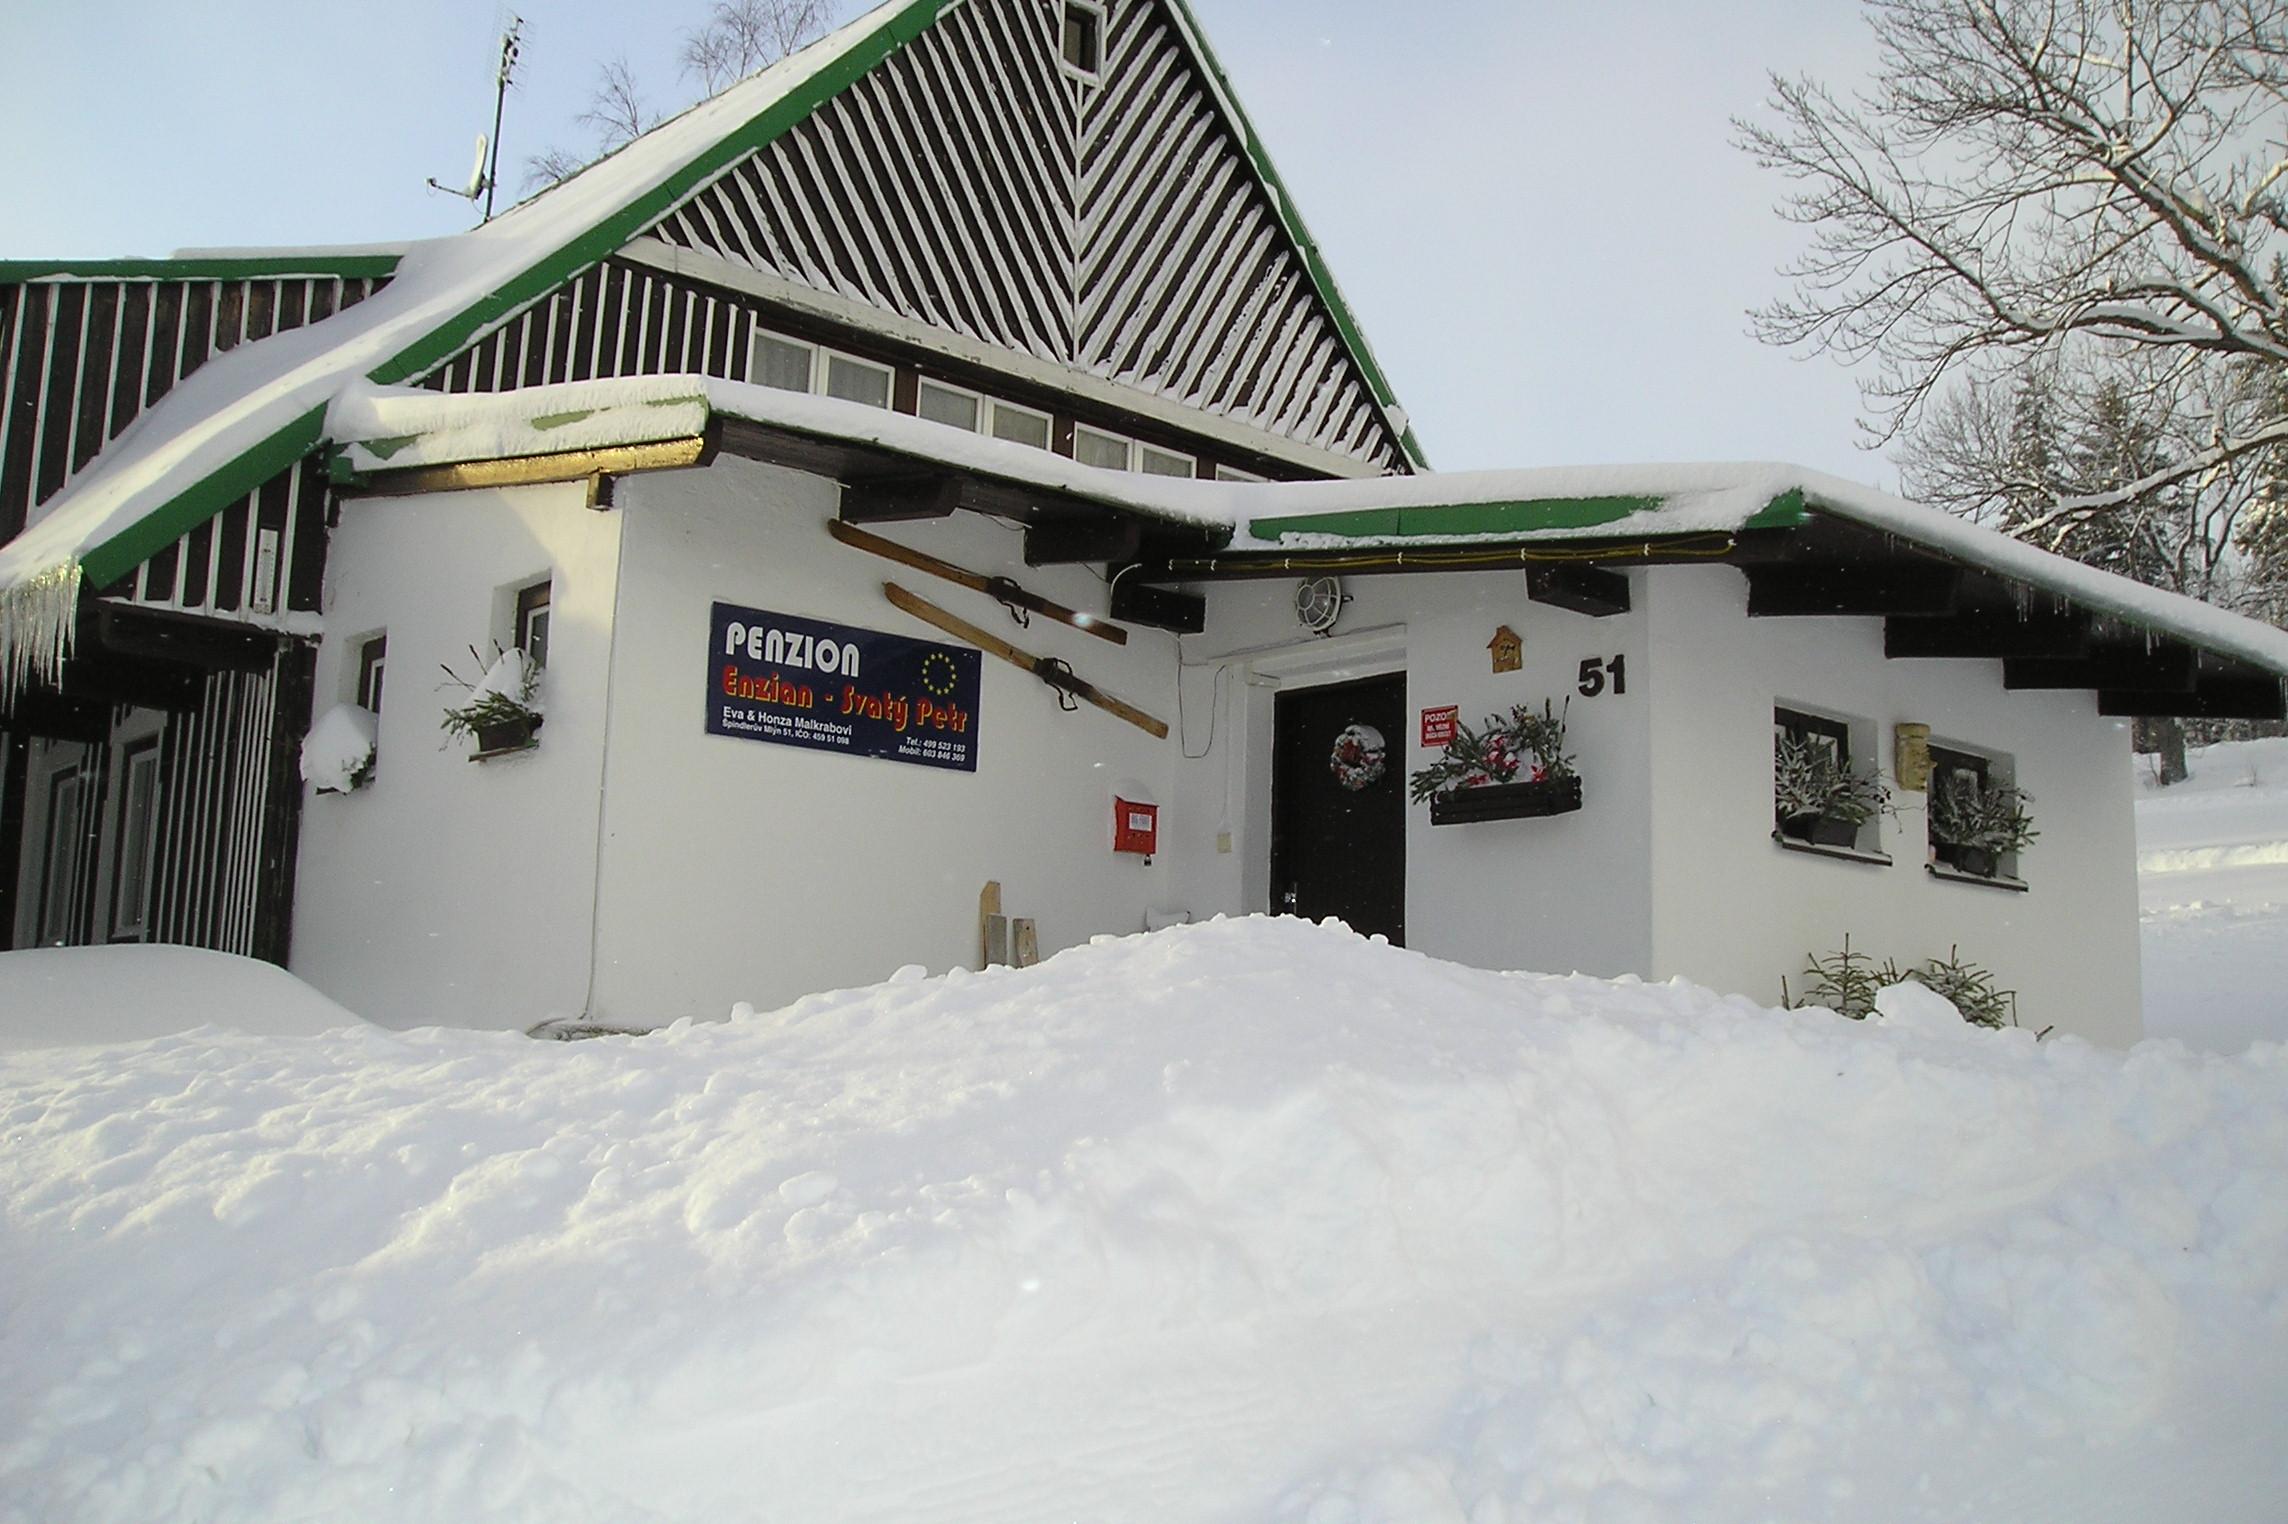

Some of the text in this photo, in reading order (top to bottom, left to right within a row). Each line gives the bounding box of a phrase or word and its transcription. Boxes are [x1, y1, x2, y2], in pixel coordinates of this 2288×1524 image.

[725, 621, 860, 678] PENZION
[1578, 654, 1625, 697] 51
[723, 706, 744, 720] Eva
[747, 710, 755, 721] &
[758, 711, 792, 727] Honza
[724, 665, 813, 708] Enzian
[841, 684, 908, 732] Svatý
[917, 696, 968, 732] Petr
[1424, 710, 1453, 723] POZO
